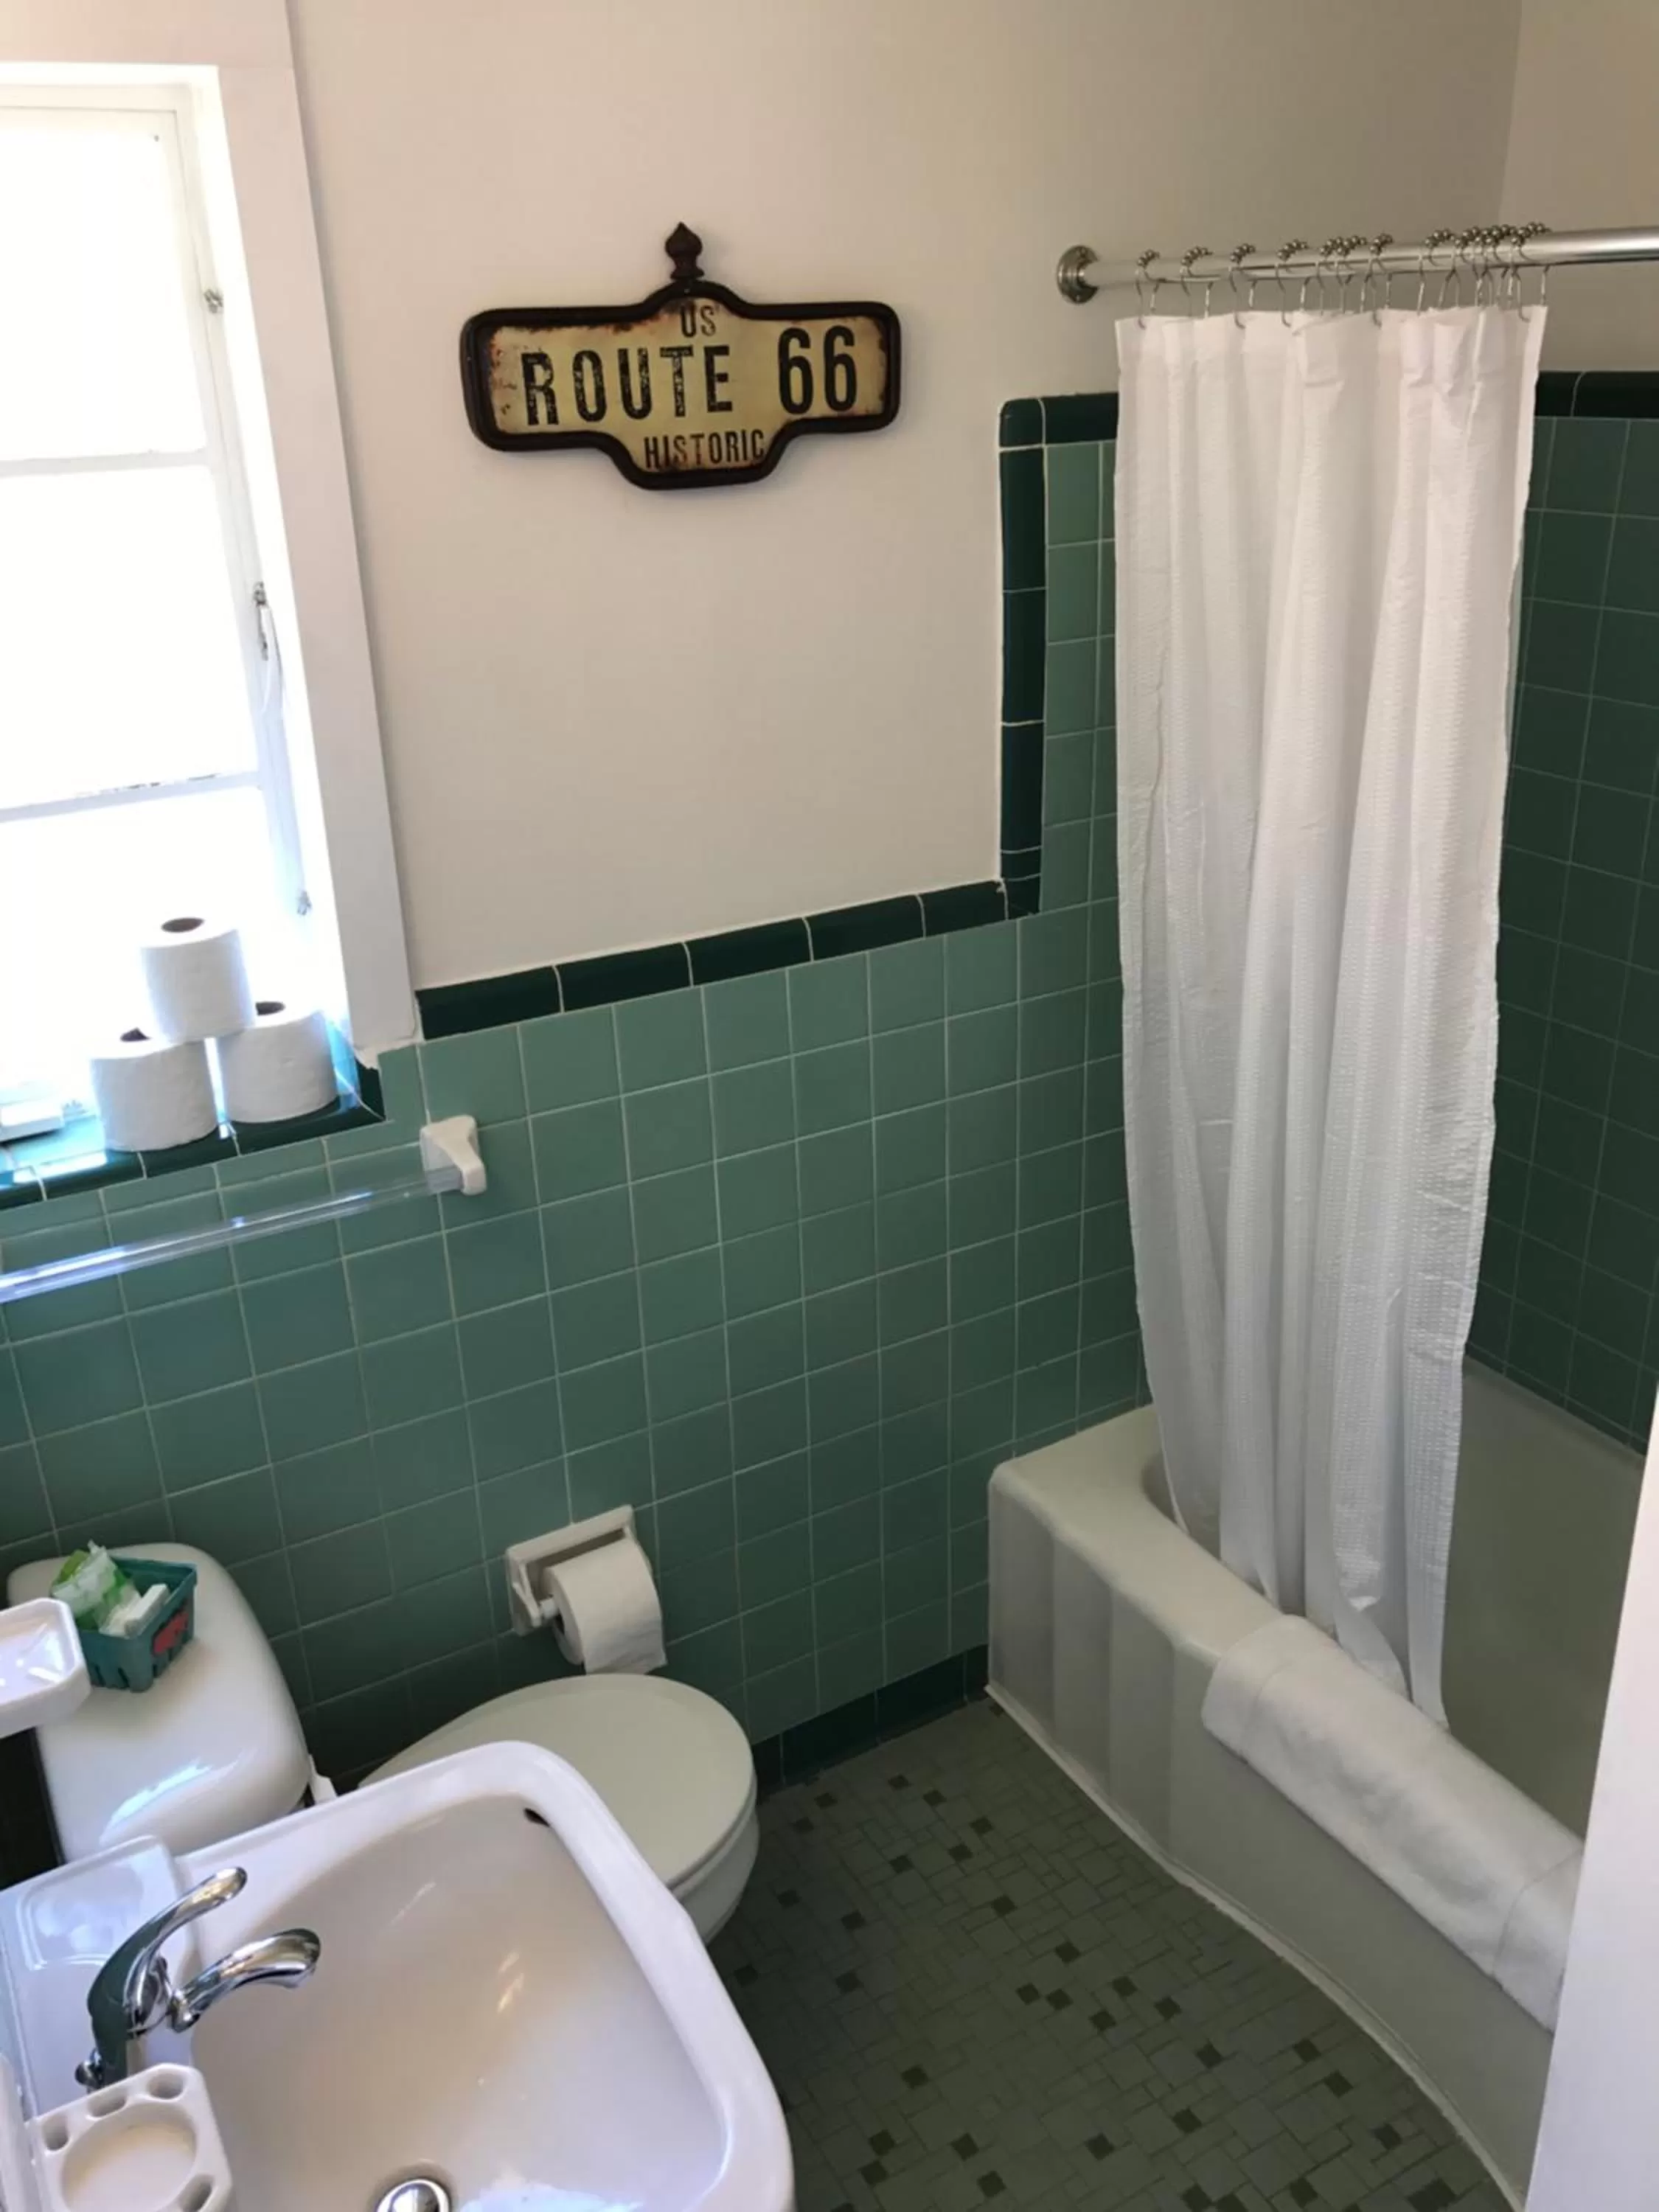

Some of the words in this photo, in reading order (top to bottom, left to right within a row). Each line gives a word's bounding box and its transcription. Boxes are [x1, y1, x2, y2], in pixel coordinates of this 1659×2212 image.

[680, 303, 717, 338] US
[521, 345, 733, 425] ROUTE
[777, 325, 858, 415] 66
[644, 429, 765, 469] HISTORIC
